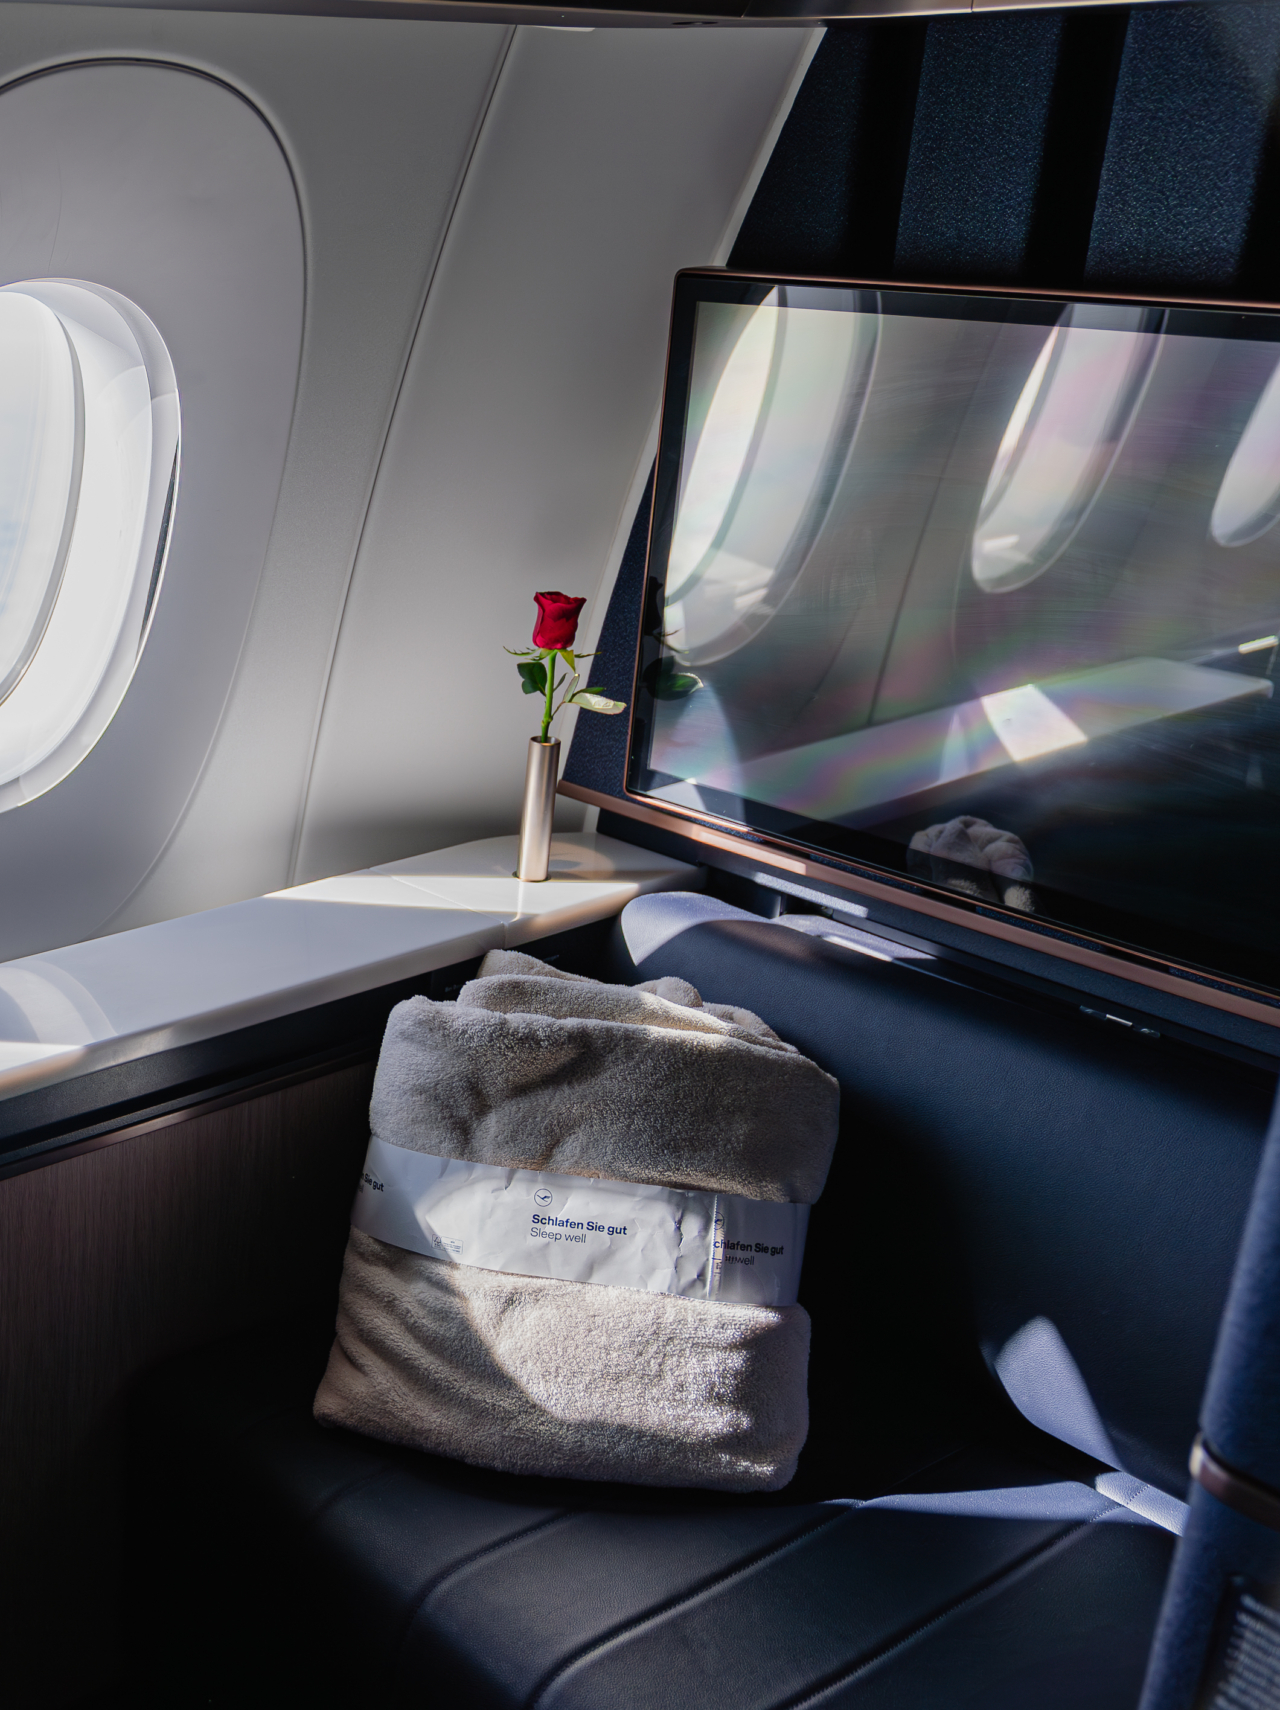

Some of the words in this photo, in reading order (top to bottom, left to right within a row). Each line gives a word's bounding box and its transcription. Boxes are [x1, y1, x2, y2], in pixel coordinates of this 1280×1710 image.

[373, 1180, 384, 1192] gut
[531, 1214, 584, 1230] Schlafen
[586, 1221, 605, 1233] Sie
[607, 1225, 628, 1236] gut
[530, 1227, 562, 1242] Sleep
[564, 1233, 587, 1243] well
[754, 1243, 770, 1254] Sie
[770, 1246, 785, 1256] gut
